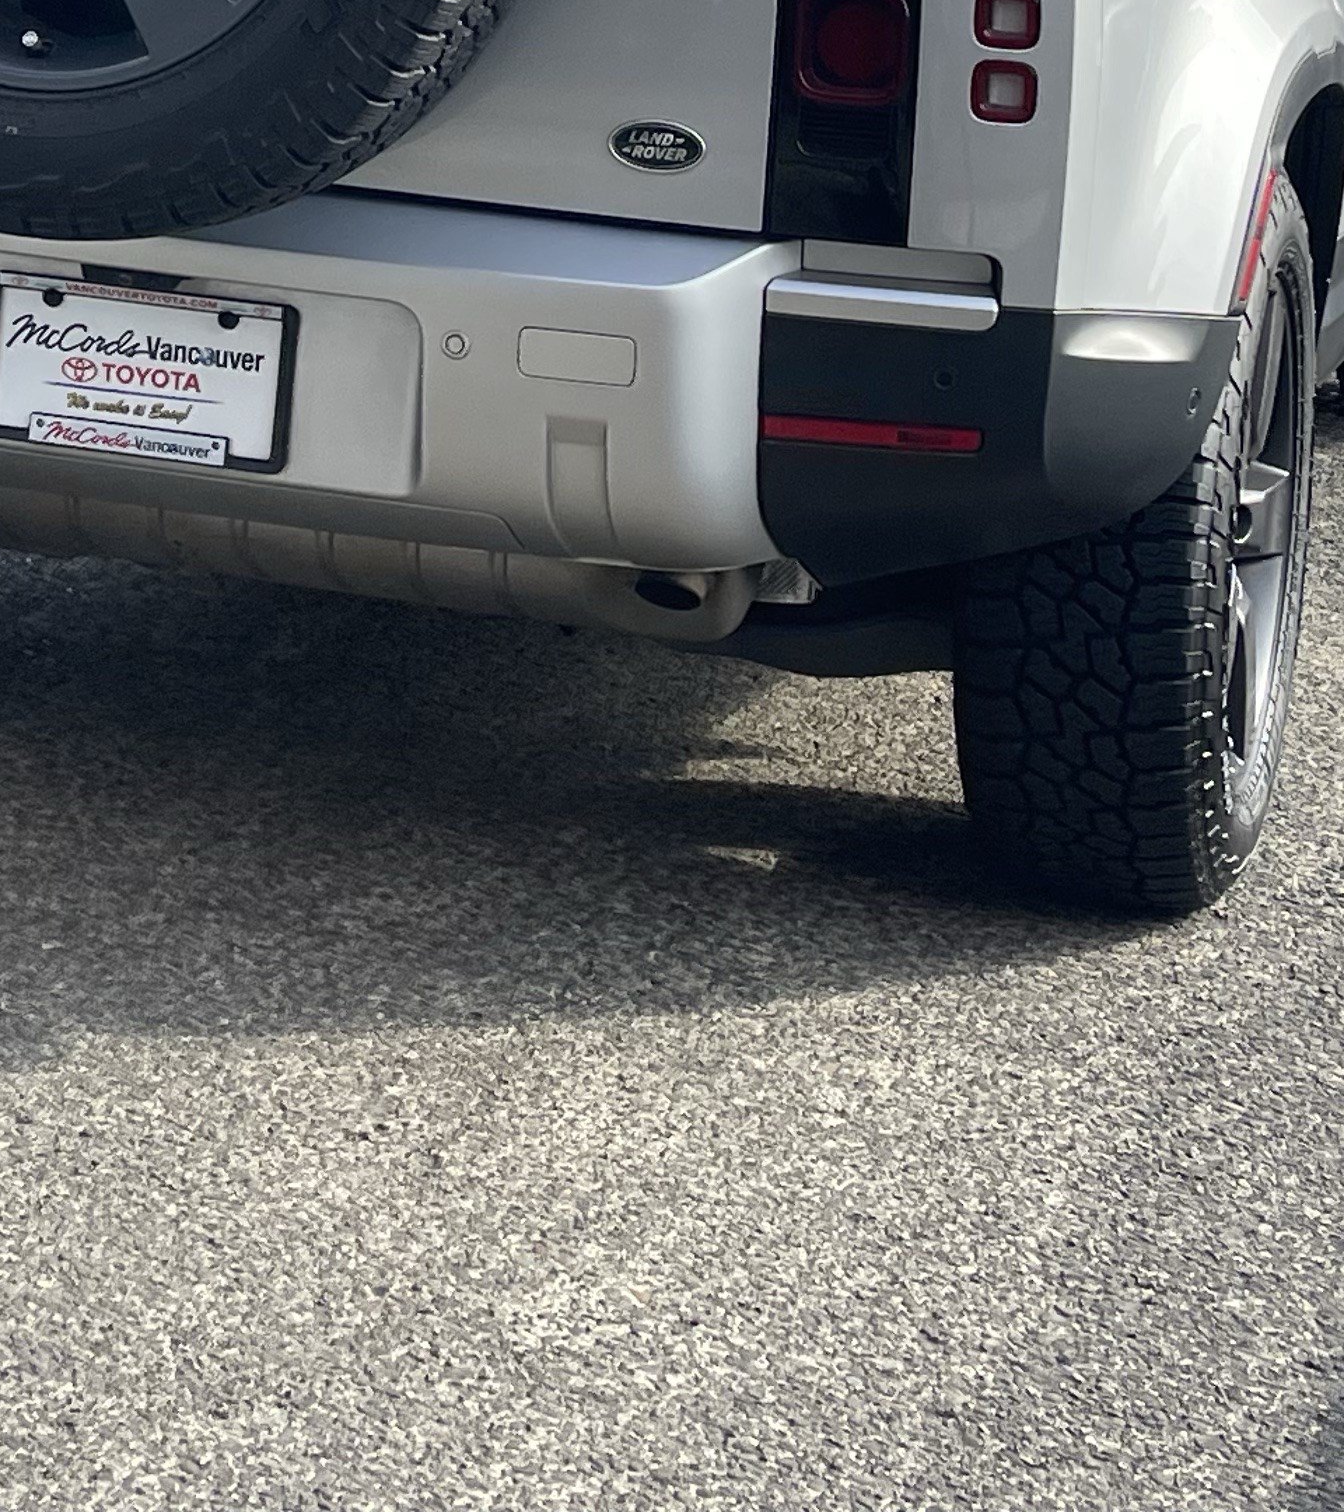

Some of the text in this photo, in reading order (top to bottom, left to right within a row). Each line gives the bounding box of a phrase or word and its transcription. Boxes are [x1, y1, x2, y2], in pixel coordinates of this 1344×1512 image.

[628, 130, 675, 147] LAND
[630, 144, 688, 162] ROVER
[65, 283, 218, 309] VANCOUVERTOYOTA.COM
[102, 362, 202, 393] TOYOTA
